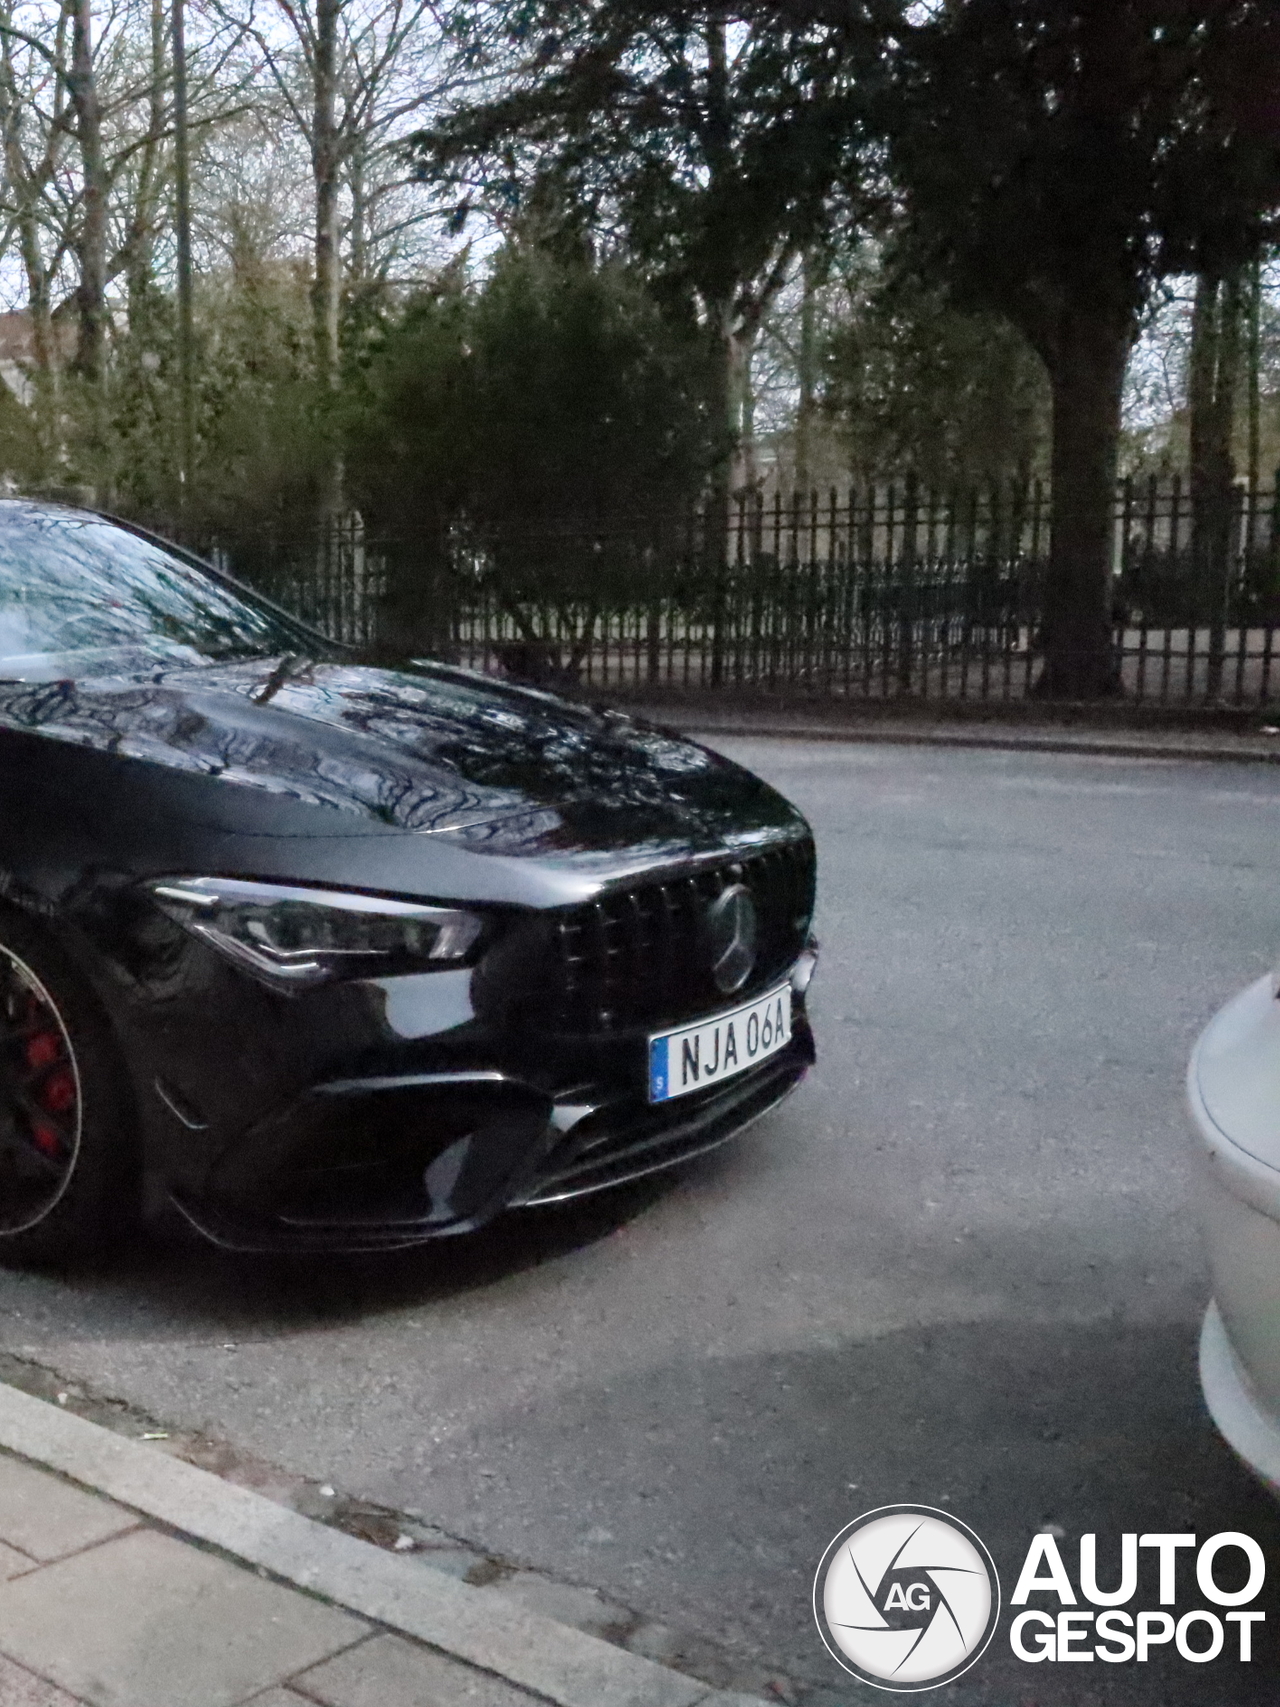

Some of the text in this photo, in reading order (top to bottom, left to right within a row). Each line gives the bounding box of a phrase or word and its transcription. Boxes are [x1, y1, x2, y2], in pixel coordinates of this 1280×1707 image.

[682, 997, 785, 1086] NJA 06A
[656, 1076, 664, 1090] S
